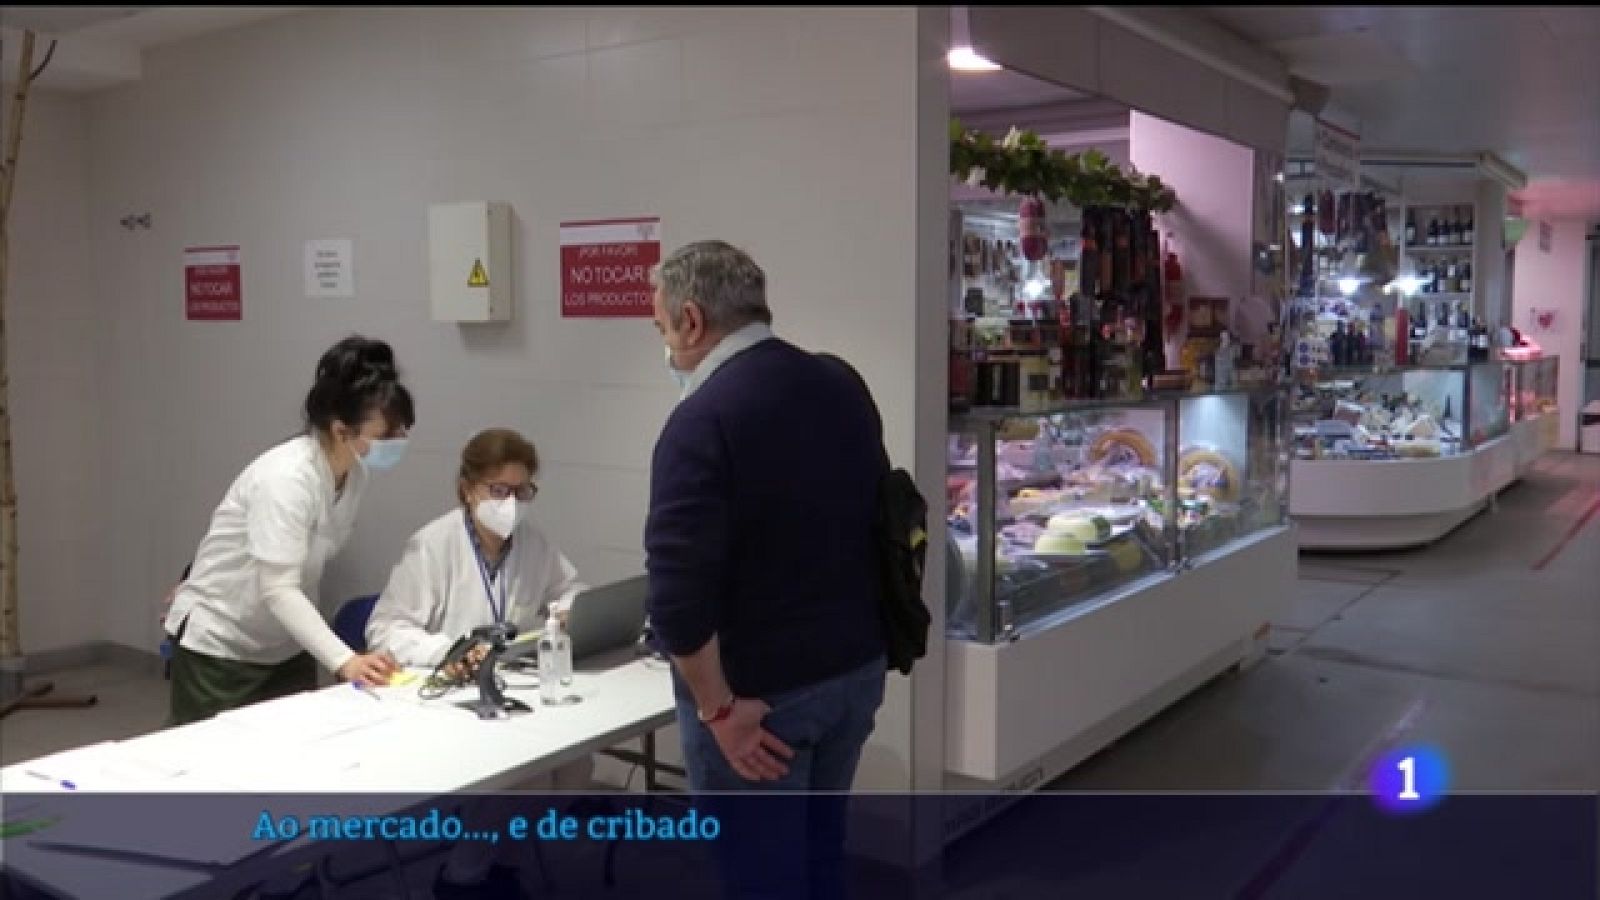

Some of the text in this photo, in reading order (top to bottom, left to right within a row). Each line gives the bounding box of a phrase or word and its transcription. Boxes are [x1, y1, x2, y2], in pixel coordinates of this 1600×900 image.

[570, 264, 643, 284] NO TOCAR
[564, 293, 586, 306] LOS
